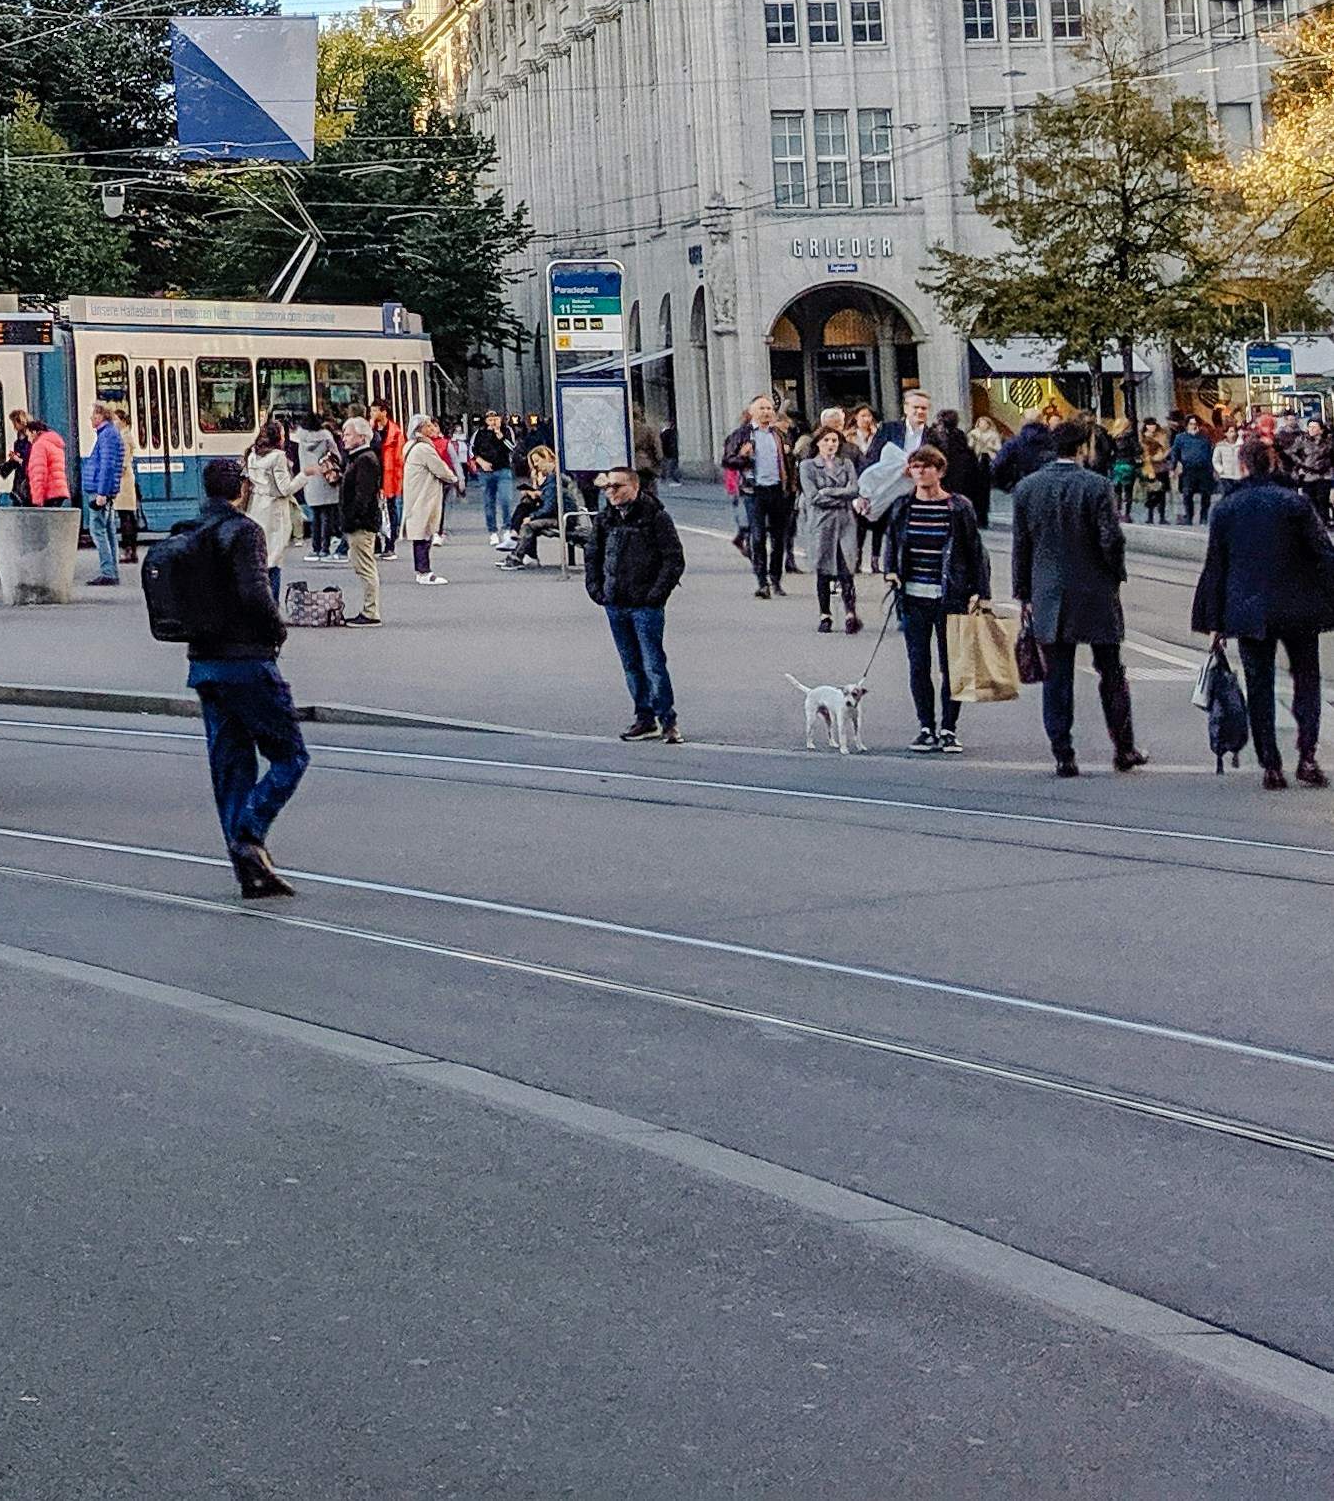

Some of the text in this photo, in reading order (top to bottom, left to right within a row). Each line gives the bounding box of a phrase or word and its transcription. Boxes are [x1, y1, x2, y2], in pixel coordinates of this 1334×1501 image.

[793, 237, 893, 257] GRIEDER
[553, 285, 599, 295] Paradeplatz
[559, 303, 571, 314] 11
